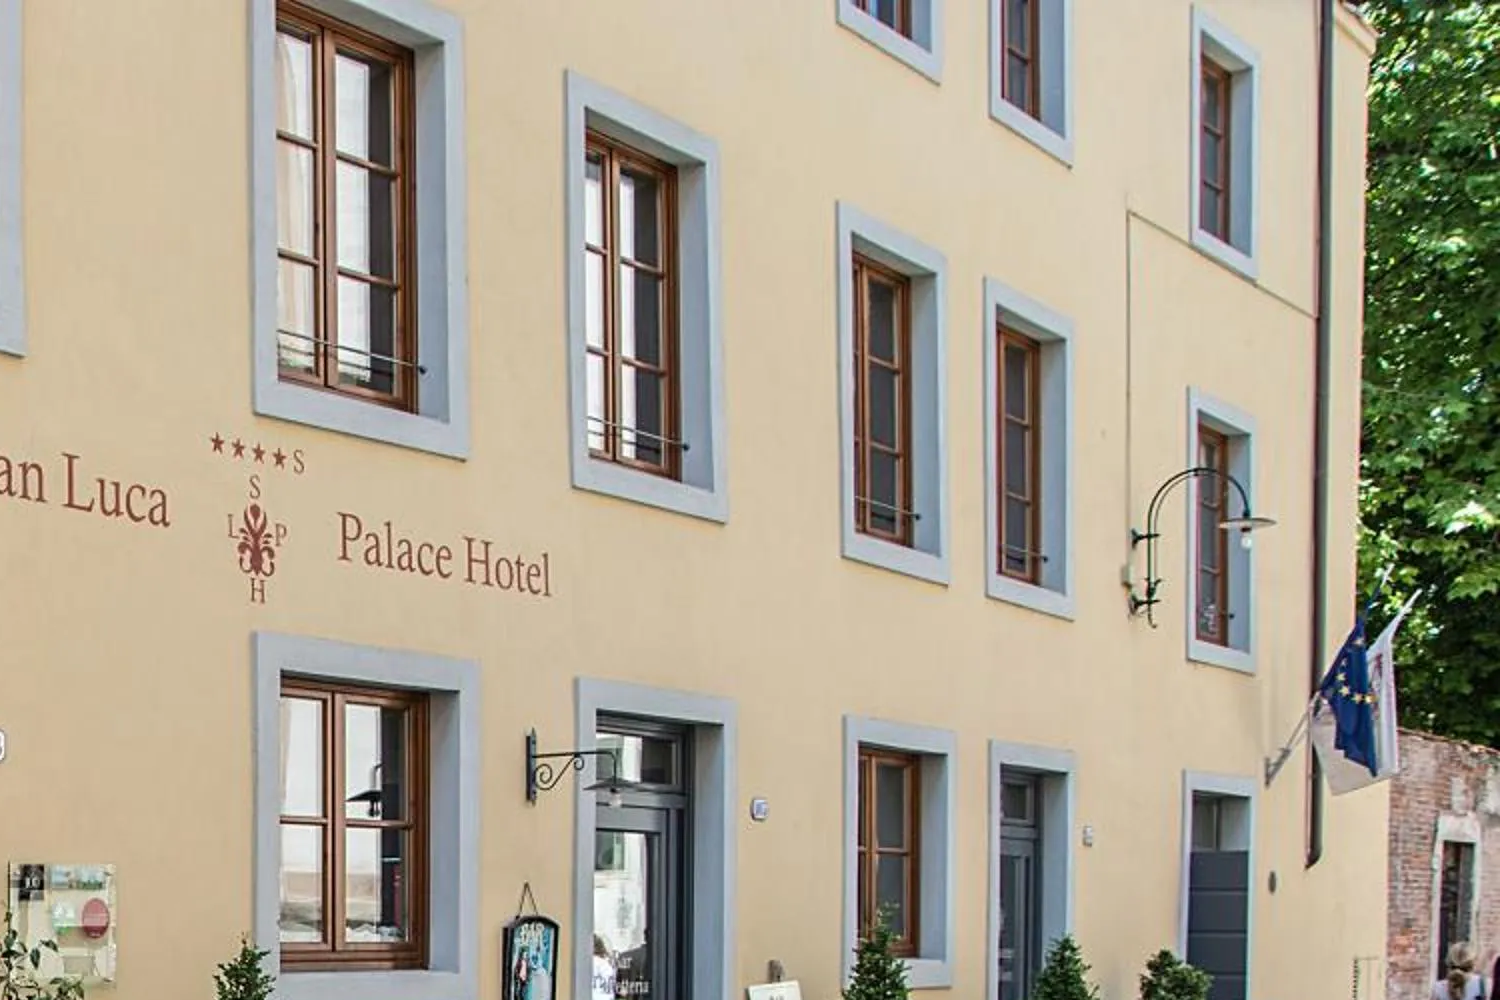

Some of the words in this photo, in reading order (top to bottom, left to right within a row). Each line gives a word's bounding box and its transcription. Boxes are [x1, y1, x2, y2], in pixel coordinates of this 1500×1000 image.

[293, 449, 305, 475] S
[61, 453, 170, 528] Luca
[249, 474, 261, 500] S
[227, 513, 240, 539] L
[275, 523, 288, 547] P
[337, 511, 453, 579] Palace
[464, 536, 552, 597] Hotel
[250, 577, 266, 603] H
[521, 921, 544, 947] BAR
